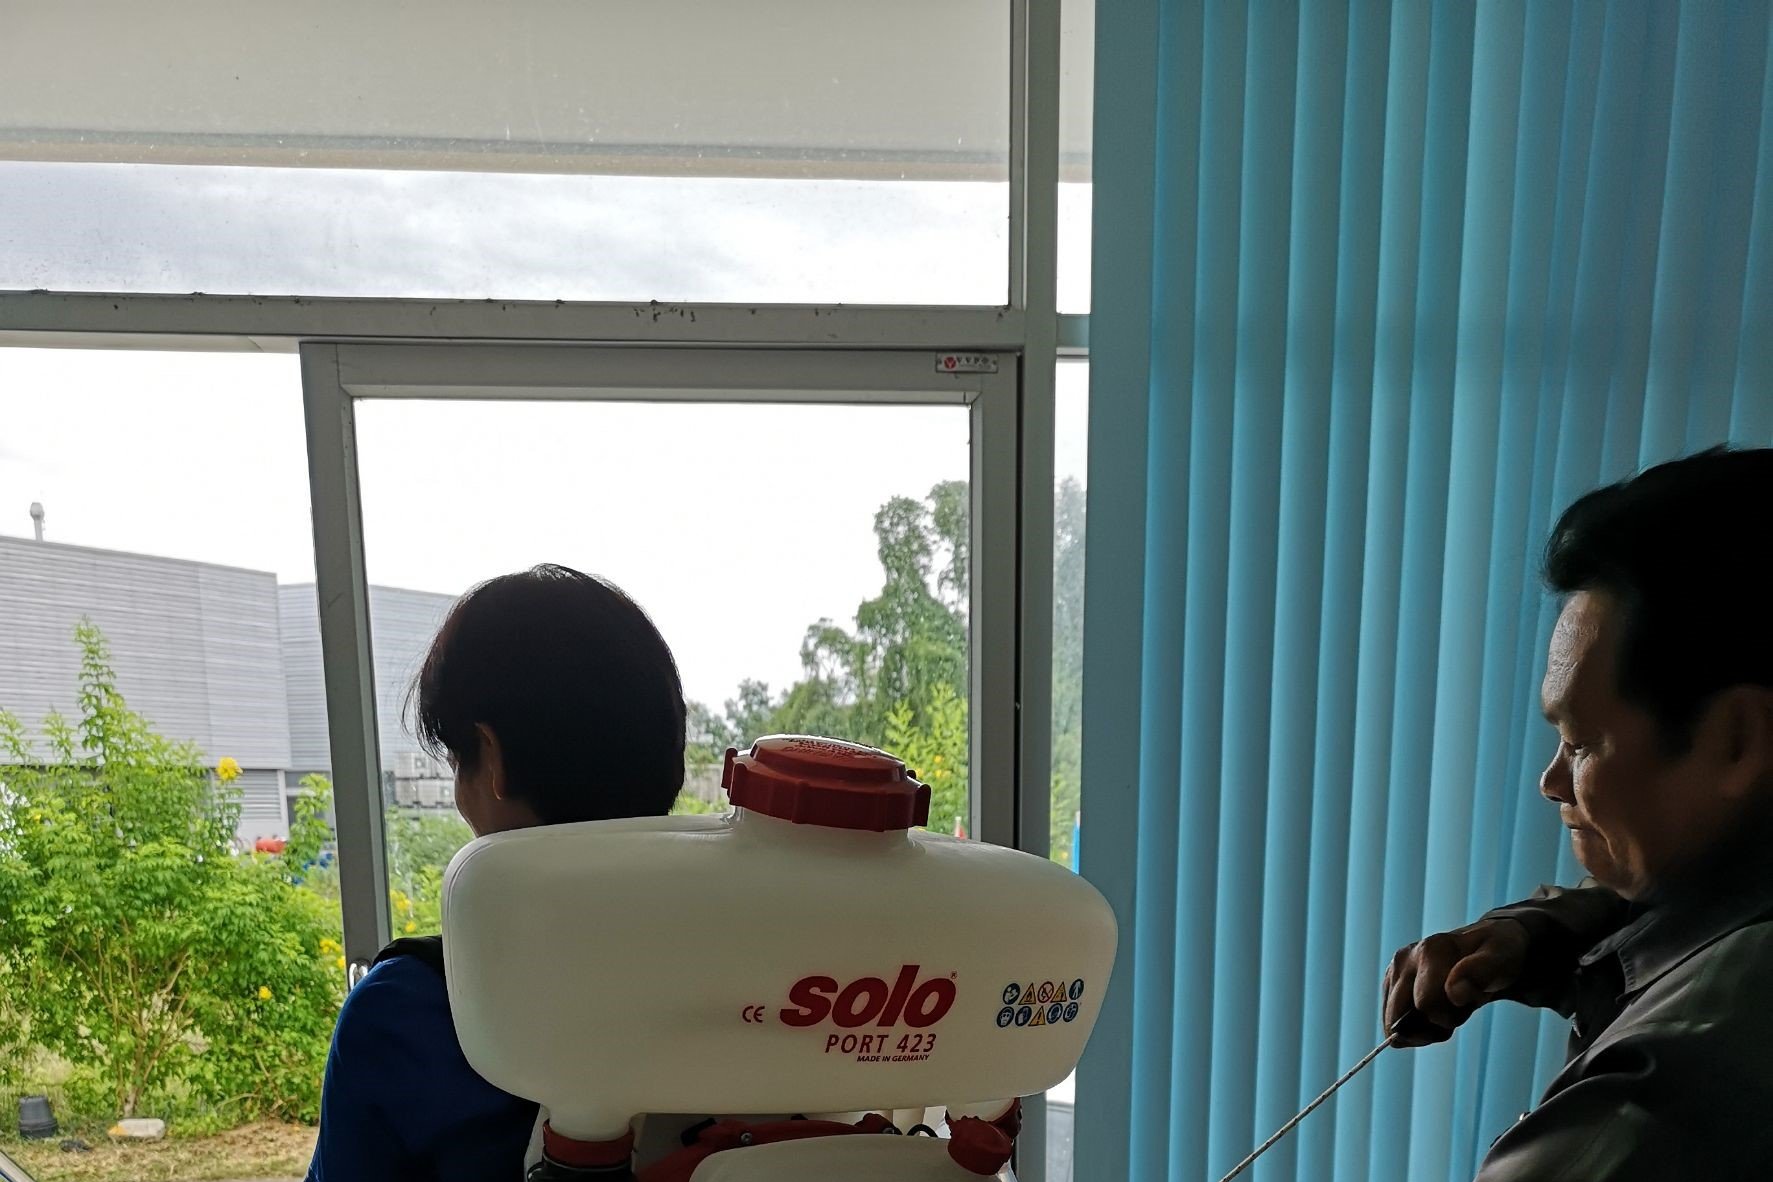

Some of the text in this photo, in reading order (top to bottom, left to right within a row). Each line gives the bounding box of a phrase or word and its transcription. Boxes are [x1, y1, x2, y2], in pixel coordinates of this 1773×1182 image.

[780, 965, 957, 1028] solo
[742, 1005, 766, 1024] CE
[824, 1033, 937, 1054] PORT 423
[856, 1055, 881, 1063] MADE
[891, 1054, 930, 1062] GERMANY
